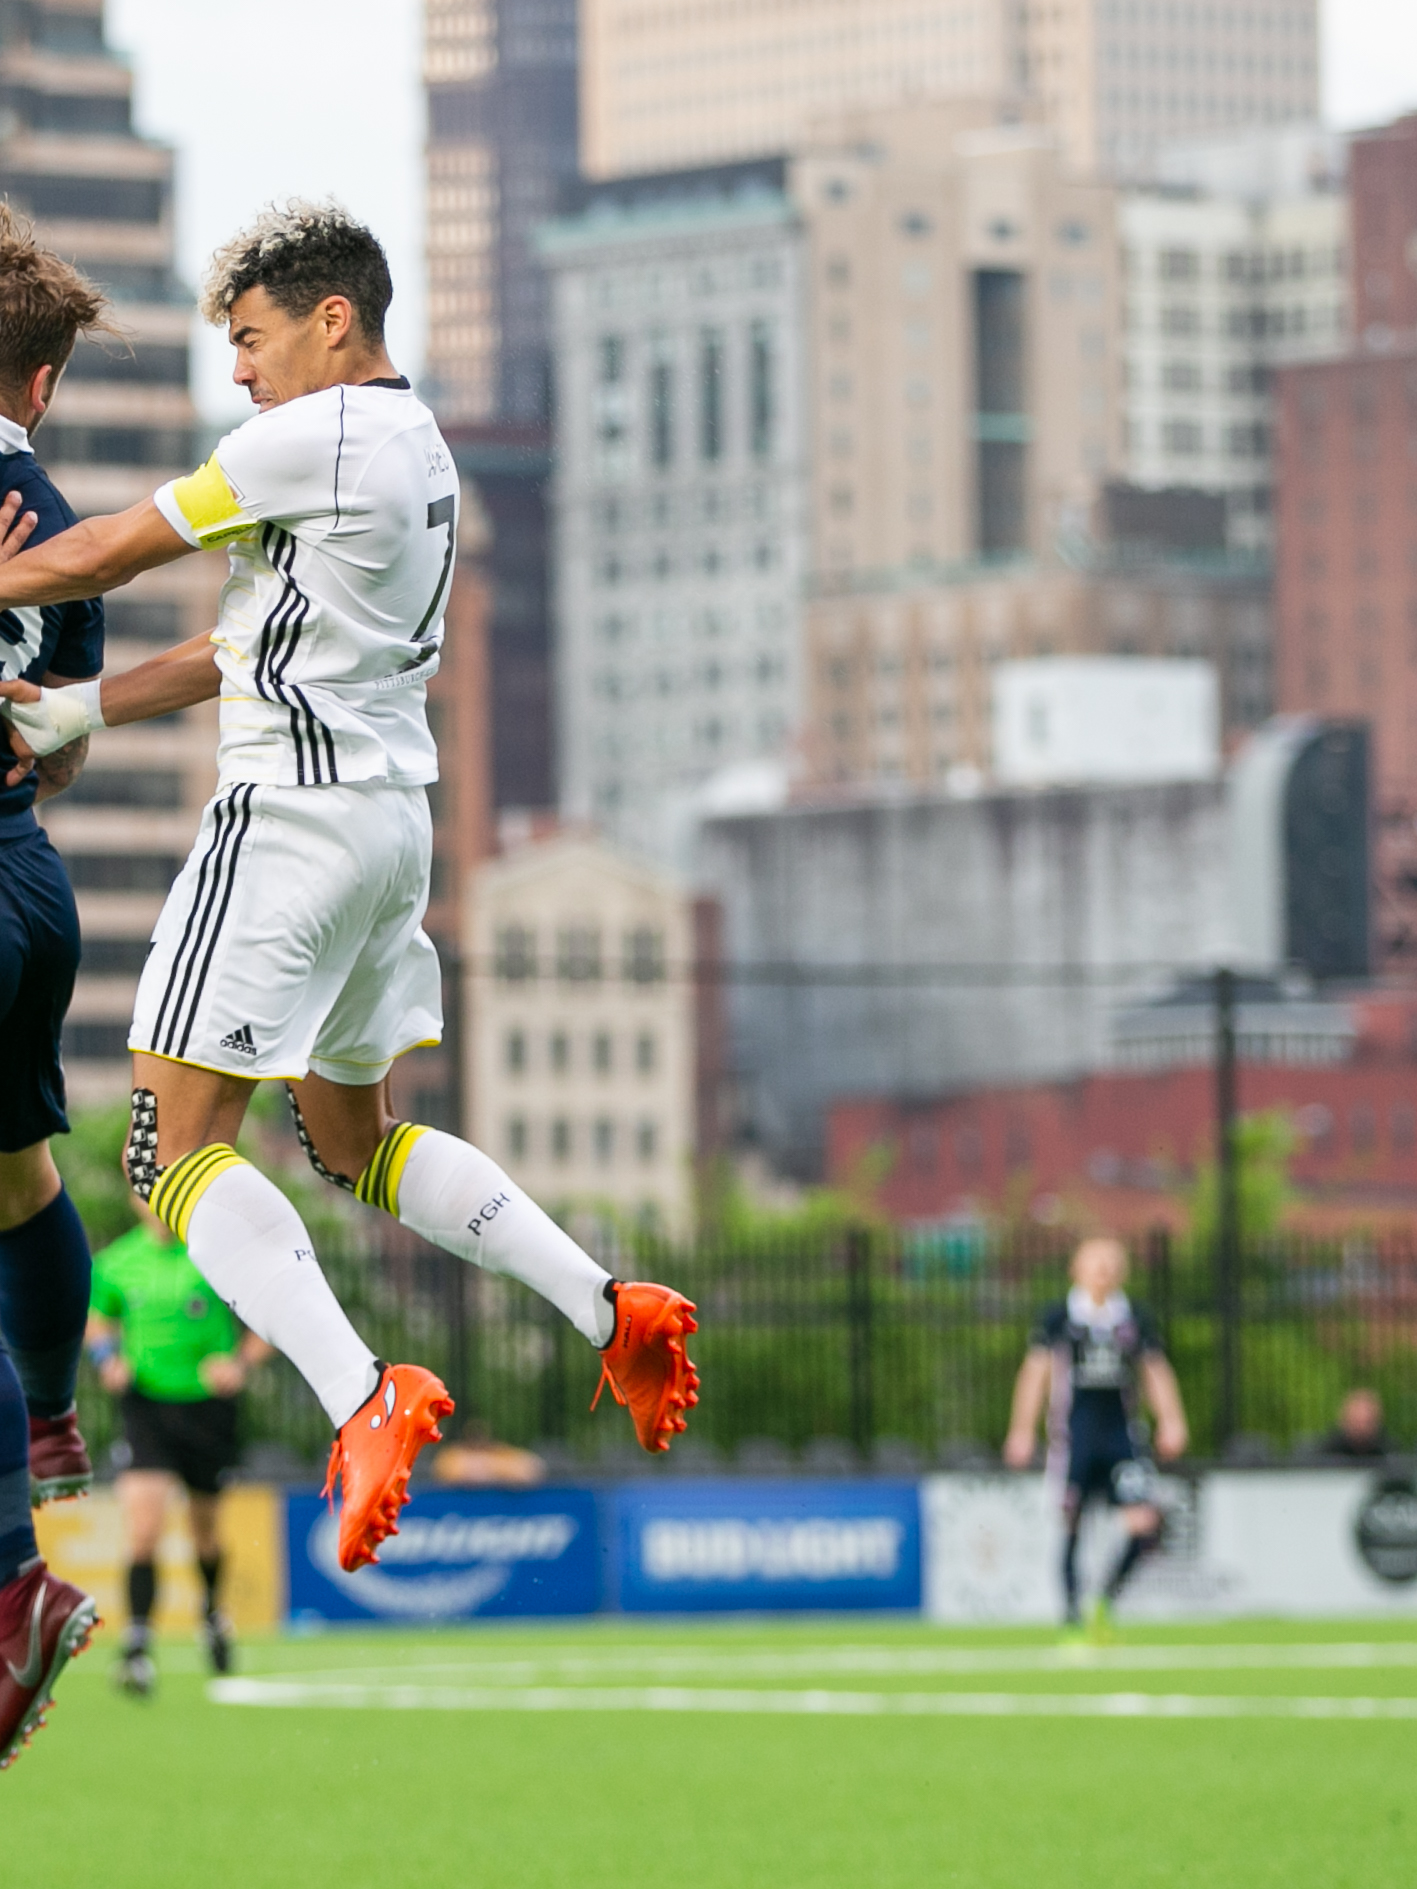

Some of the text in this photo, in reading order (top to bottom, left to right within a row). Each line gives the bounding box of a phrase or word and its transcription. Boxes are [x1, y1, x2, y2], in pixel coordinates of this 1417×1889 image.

[394, 494, 455, 672] 7
[219, 1038, 258, 1056] adidas
[467, 1192, 511, 1237] PGH
